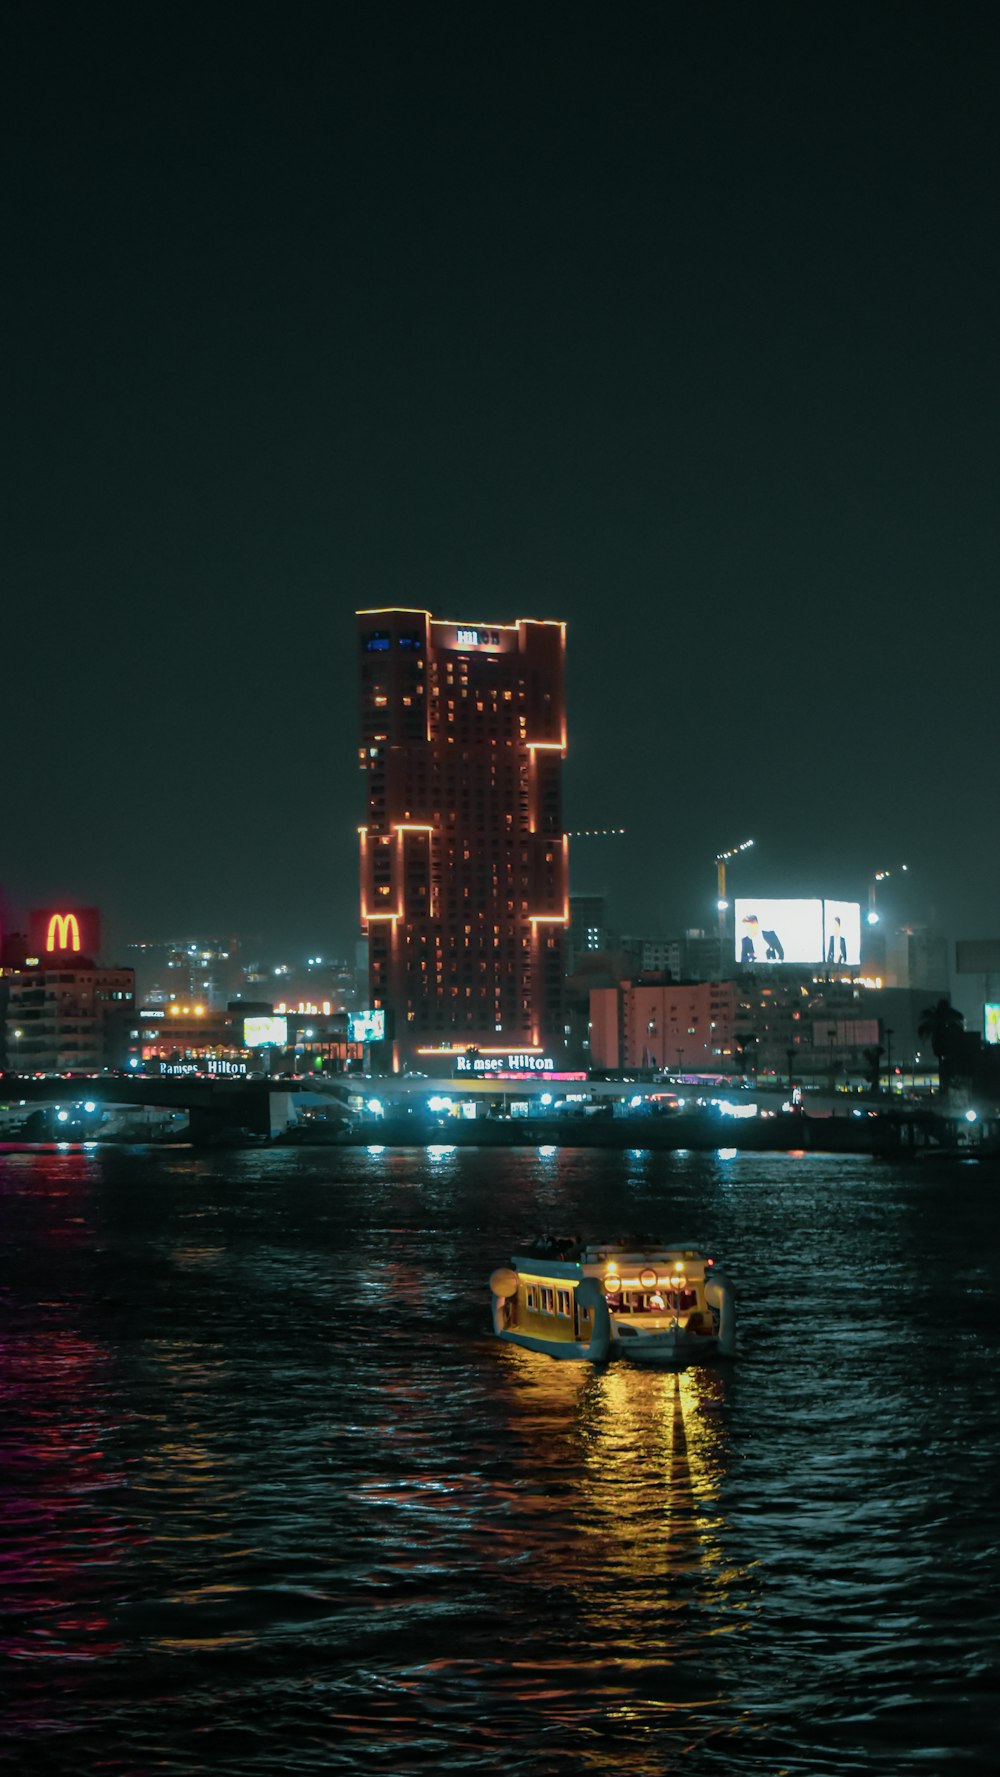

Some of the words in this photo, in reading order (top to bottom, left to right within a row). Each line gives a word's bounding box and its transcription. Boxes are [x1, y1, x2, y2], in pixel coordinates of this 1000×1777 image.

[457, 631, 499, 645] Hilon
[160, 1062, 198, 1075] Ramses
[208, 1061, 246, 1074] Hilton
[508, 1055, 554, 1070] Hilton
